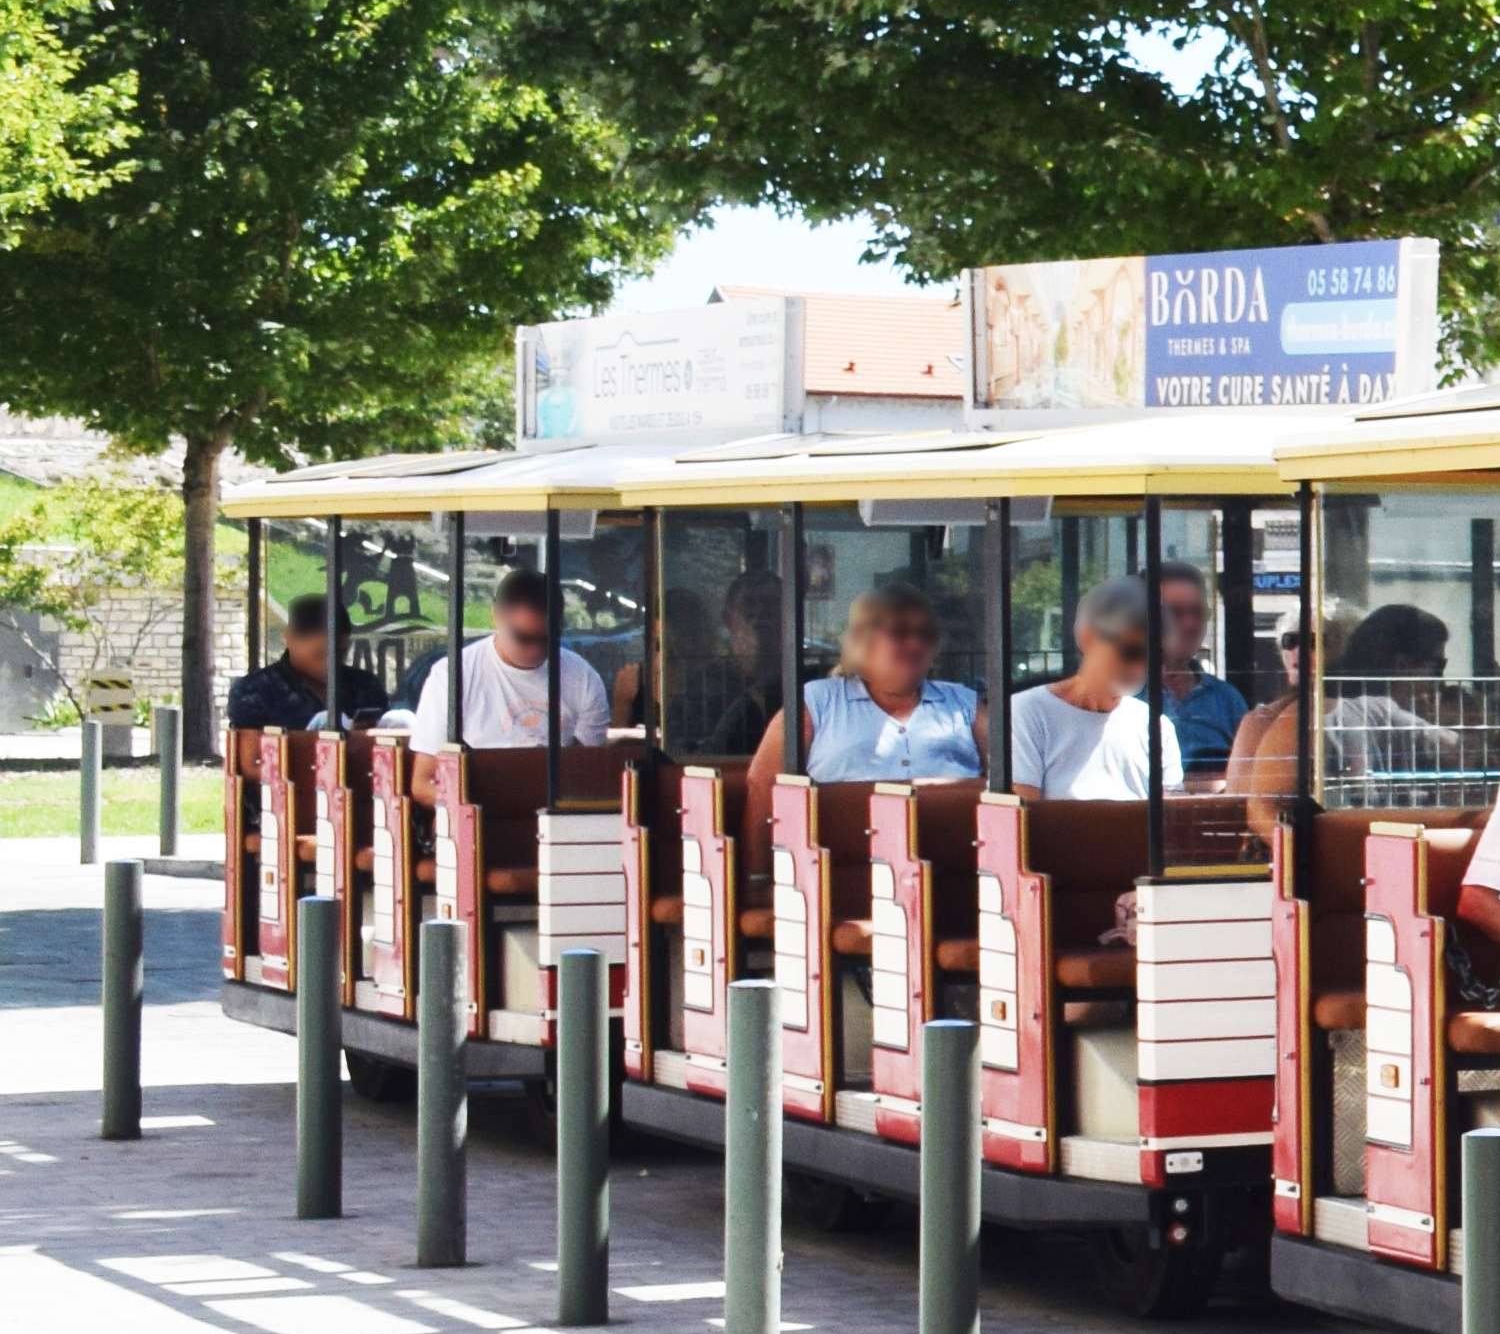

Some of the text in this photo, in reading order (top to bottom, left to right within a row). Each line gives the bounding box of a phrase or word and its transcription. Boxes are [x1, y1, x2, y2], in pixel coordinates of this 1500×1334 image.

[1308, 269, 1327, 295] 05
[1330, 268, 1348, 294] 58
[1354, 267, 1373, 293] 74
[1168, 338, 1214, 356] THERMES
[1230, 338, 1251, 354] SPA
[594, 358, 617, 398] Les
[621, 354, 680, 396] Thermes
[1158, 377, 1211, 405] VOTRE
[1218, 377, 1264, 404] CURE
[1271, 366, 1330, 403] SANTÉ
[1336, 364, 1350, 403] À
